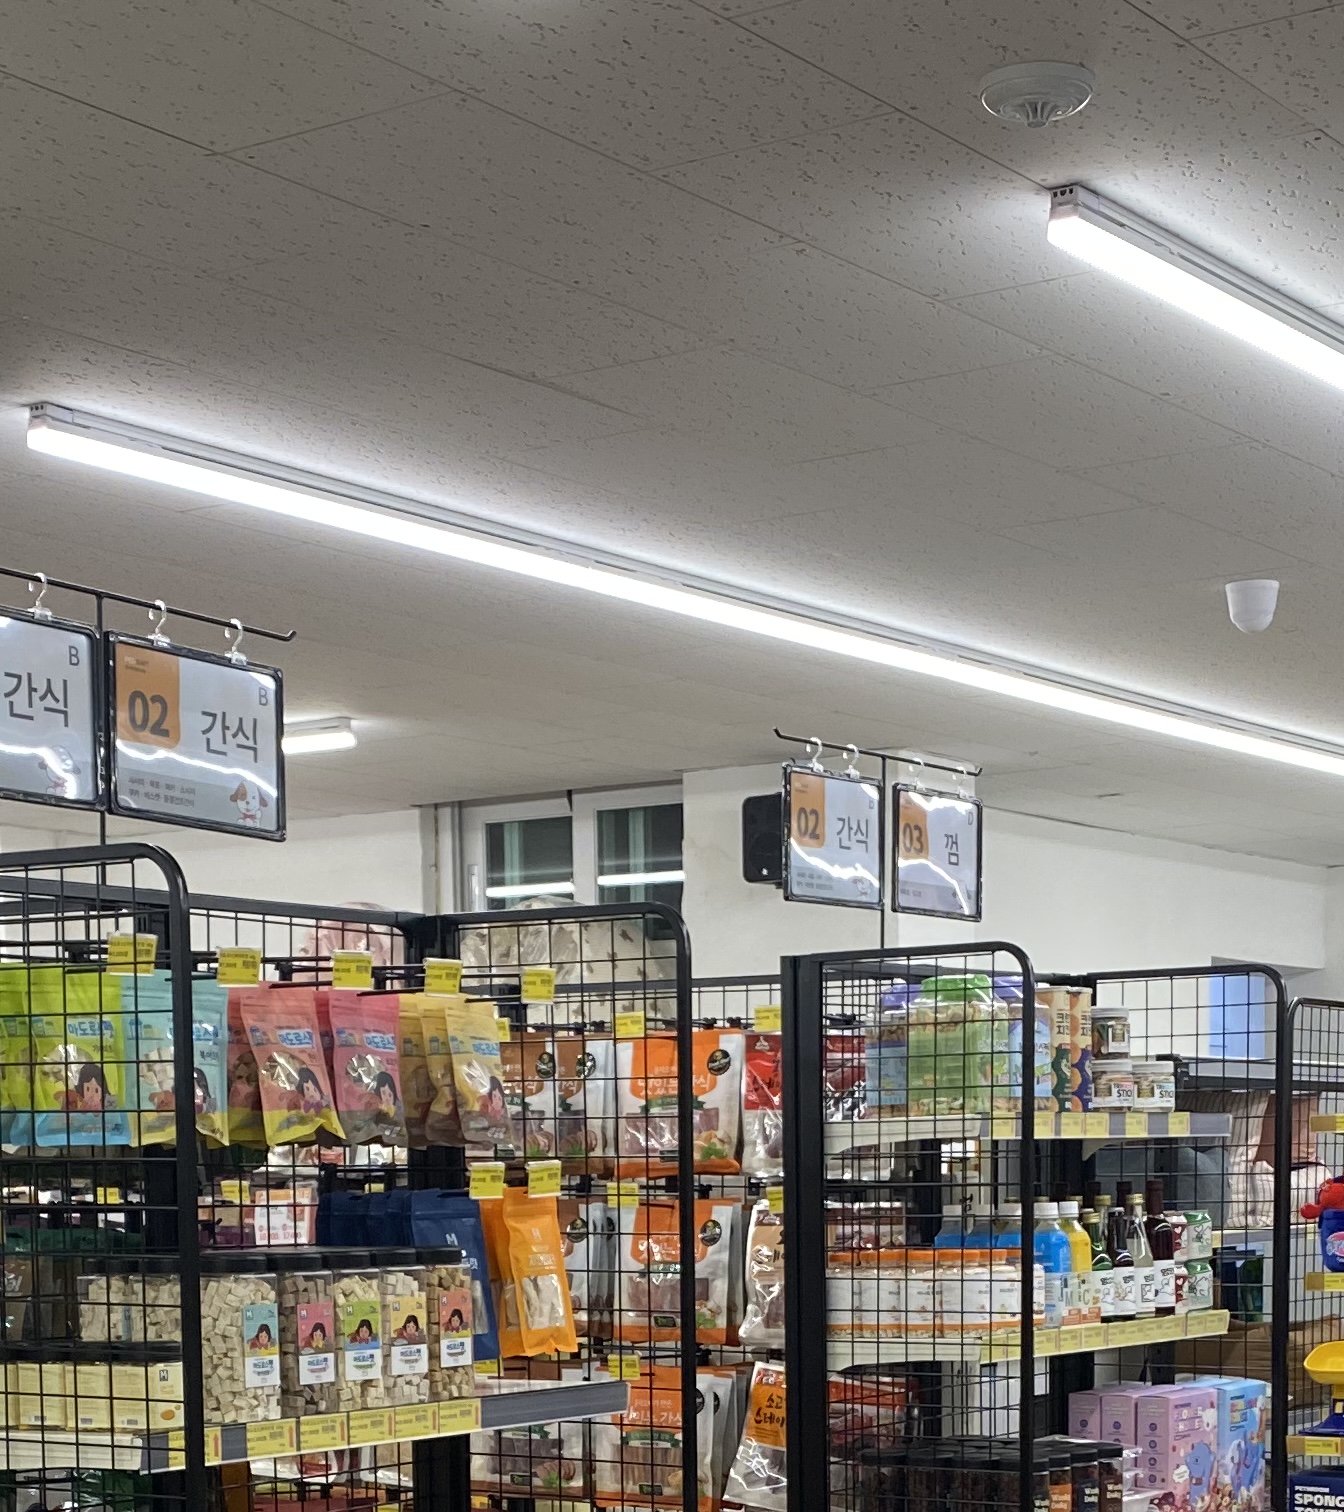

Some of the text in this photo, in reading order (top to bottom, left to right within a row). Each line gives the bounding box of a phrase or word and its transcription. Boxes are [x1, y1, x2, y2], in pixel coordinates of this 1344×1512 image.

[68, 644, 80, 667] B
[2, 670, 70, 728] 간식
[128, 689, 170, 738] 02
[258, 686, 269, 707] B
[200, 708, 258, 764] 간식
[797, 806, 820, 840] 02
[835, 815, 869, 853] 간식
[901, 822, 924, 855] 03
[943, 832, 960, 866] 껌
